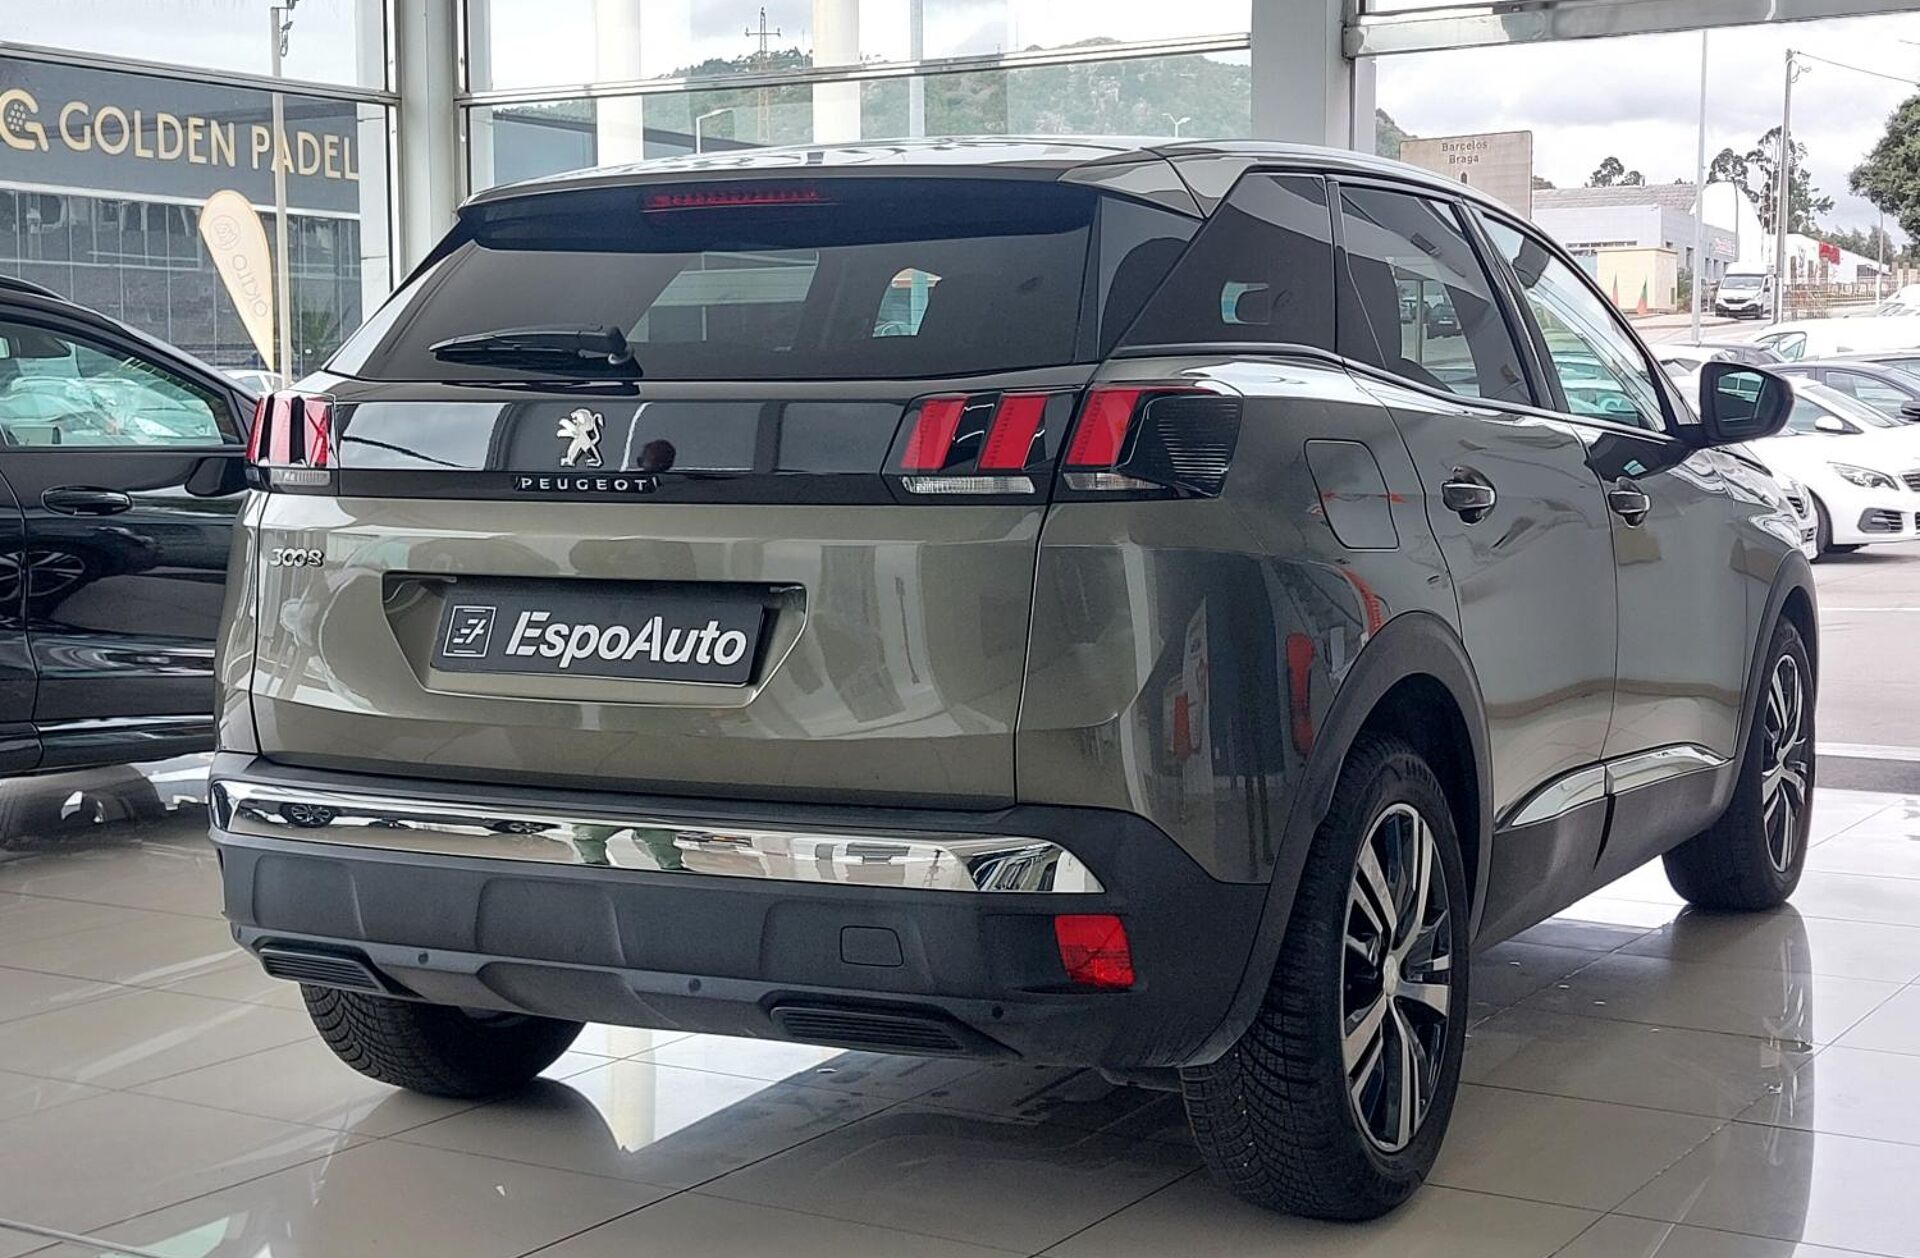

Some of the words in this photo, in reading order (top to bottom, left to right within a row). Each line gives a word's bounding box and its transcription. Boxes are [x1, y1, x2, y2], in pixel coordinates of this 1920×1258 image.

[58, 101, 237, 168] GOLDEN
[1441, 140, 1488, 152] Barcelos
[1448, 154, 1480, 165] Braga
[520, 476, 648, 492] PEUGEOT
[269, 547, 325, 568] 3008
[505, 610, 747, 669] EspoAuto
